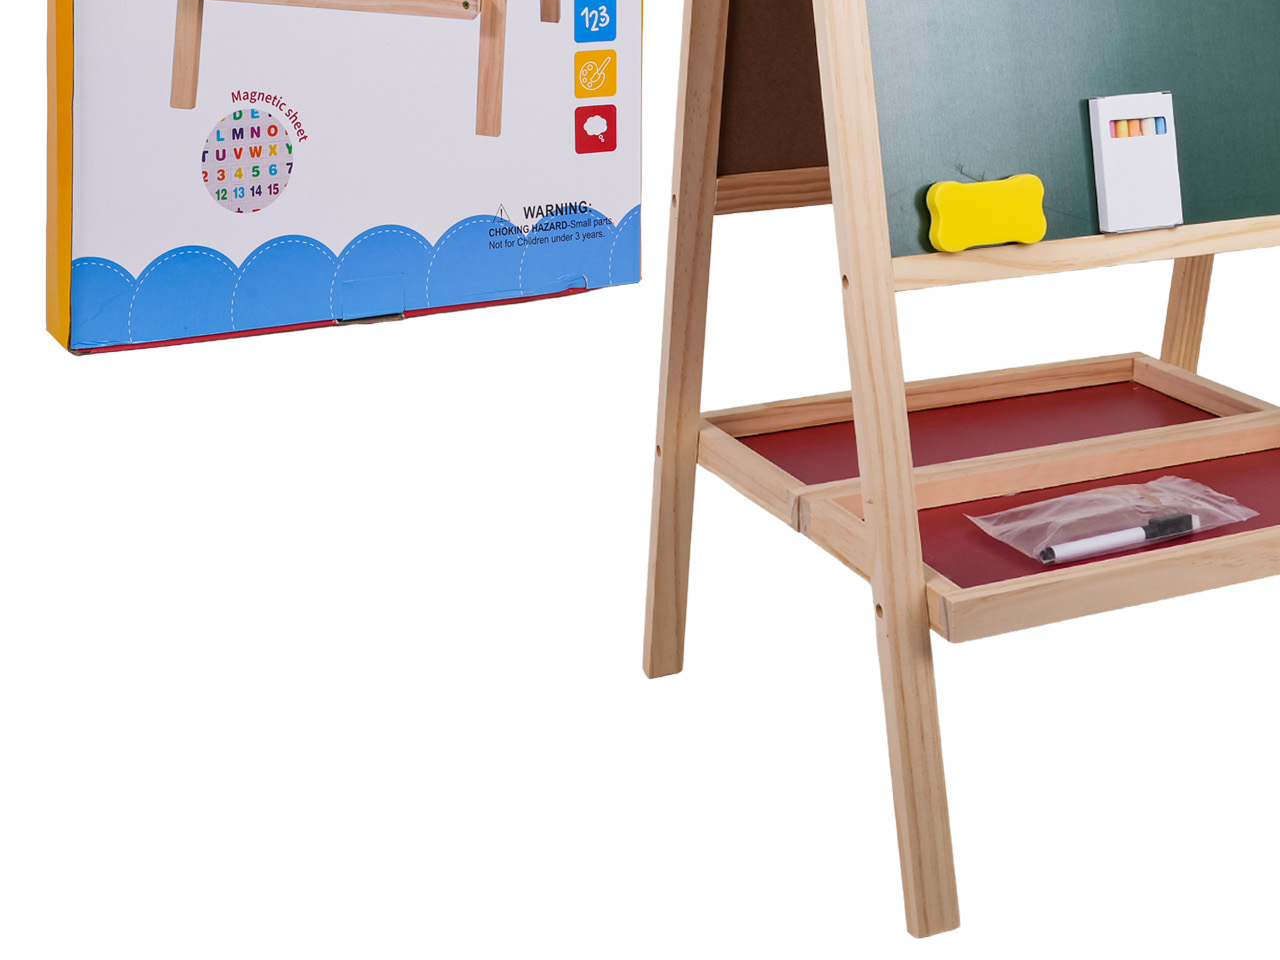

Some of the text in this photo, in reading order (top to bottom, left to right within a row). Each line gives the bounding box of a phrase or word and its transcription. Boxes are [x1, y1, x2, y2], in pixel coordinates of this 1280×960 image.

[581, 6, 610, 31] 123
[231, 90, 308, 142] Magnetic sheet
[217, 125, 278, 141] L M N O
[216, 149, 226, 161] U
[234, 147, 243, 159] V
[249, 146, 262, 158] W
[269, 144, 277, 156] X
[217, 169, 225, 180] 3
[234, 168, 243, 179] 4
[252, 166, 260, 177] 5
[269, 164, 277, 175] 6
[215, 183, 279, 200] 12 13 14 15
[523, 201, 592, 219] WARNING:
[489, 225, 529, 237] CHOKING
[532, 218, 591, 232] HAZARD-Small
[489, 230, 605, 249] Not for Children under 3 years.
